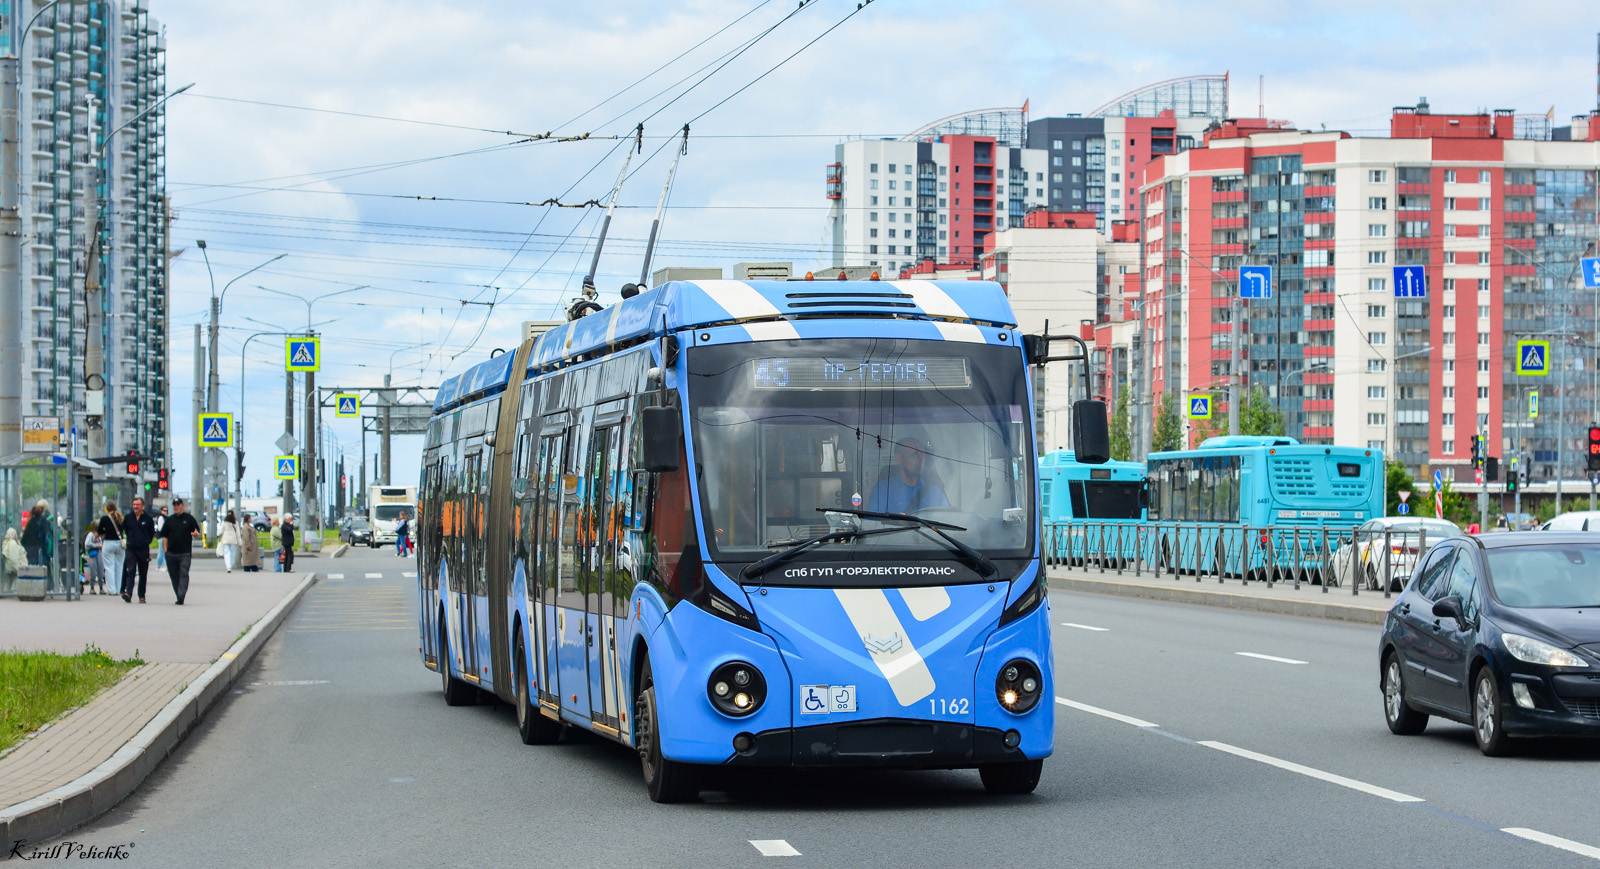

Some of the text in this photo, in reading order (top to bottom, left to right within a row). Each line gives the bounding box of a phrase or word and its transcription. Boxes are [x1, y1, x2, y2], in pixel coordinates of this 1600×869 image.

[754, 359, 789, 387] 45
[129, 464, 138, 473] 64
[159, 480, 168, 488] 64
[784, 566, 956, 577] СПб ГУП «ГОРЭЛЕКТРОТРАНС»
[929, 698, 969, 715] 1162
